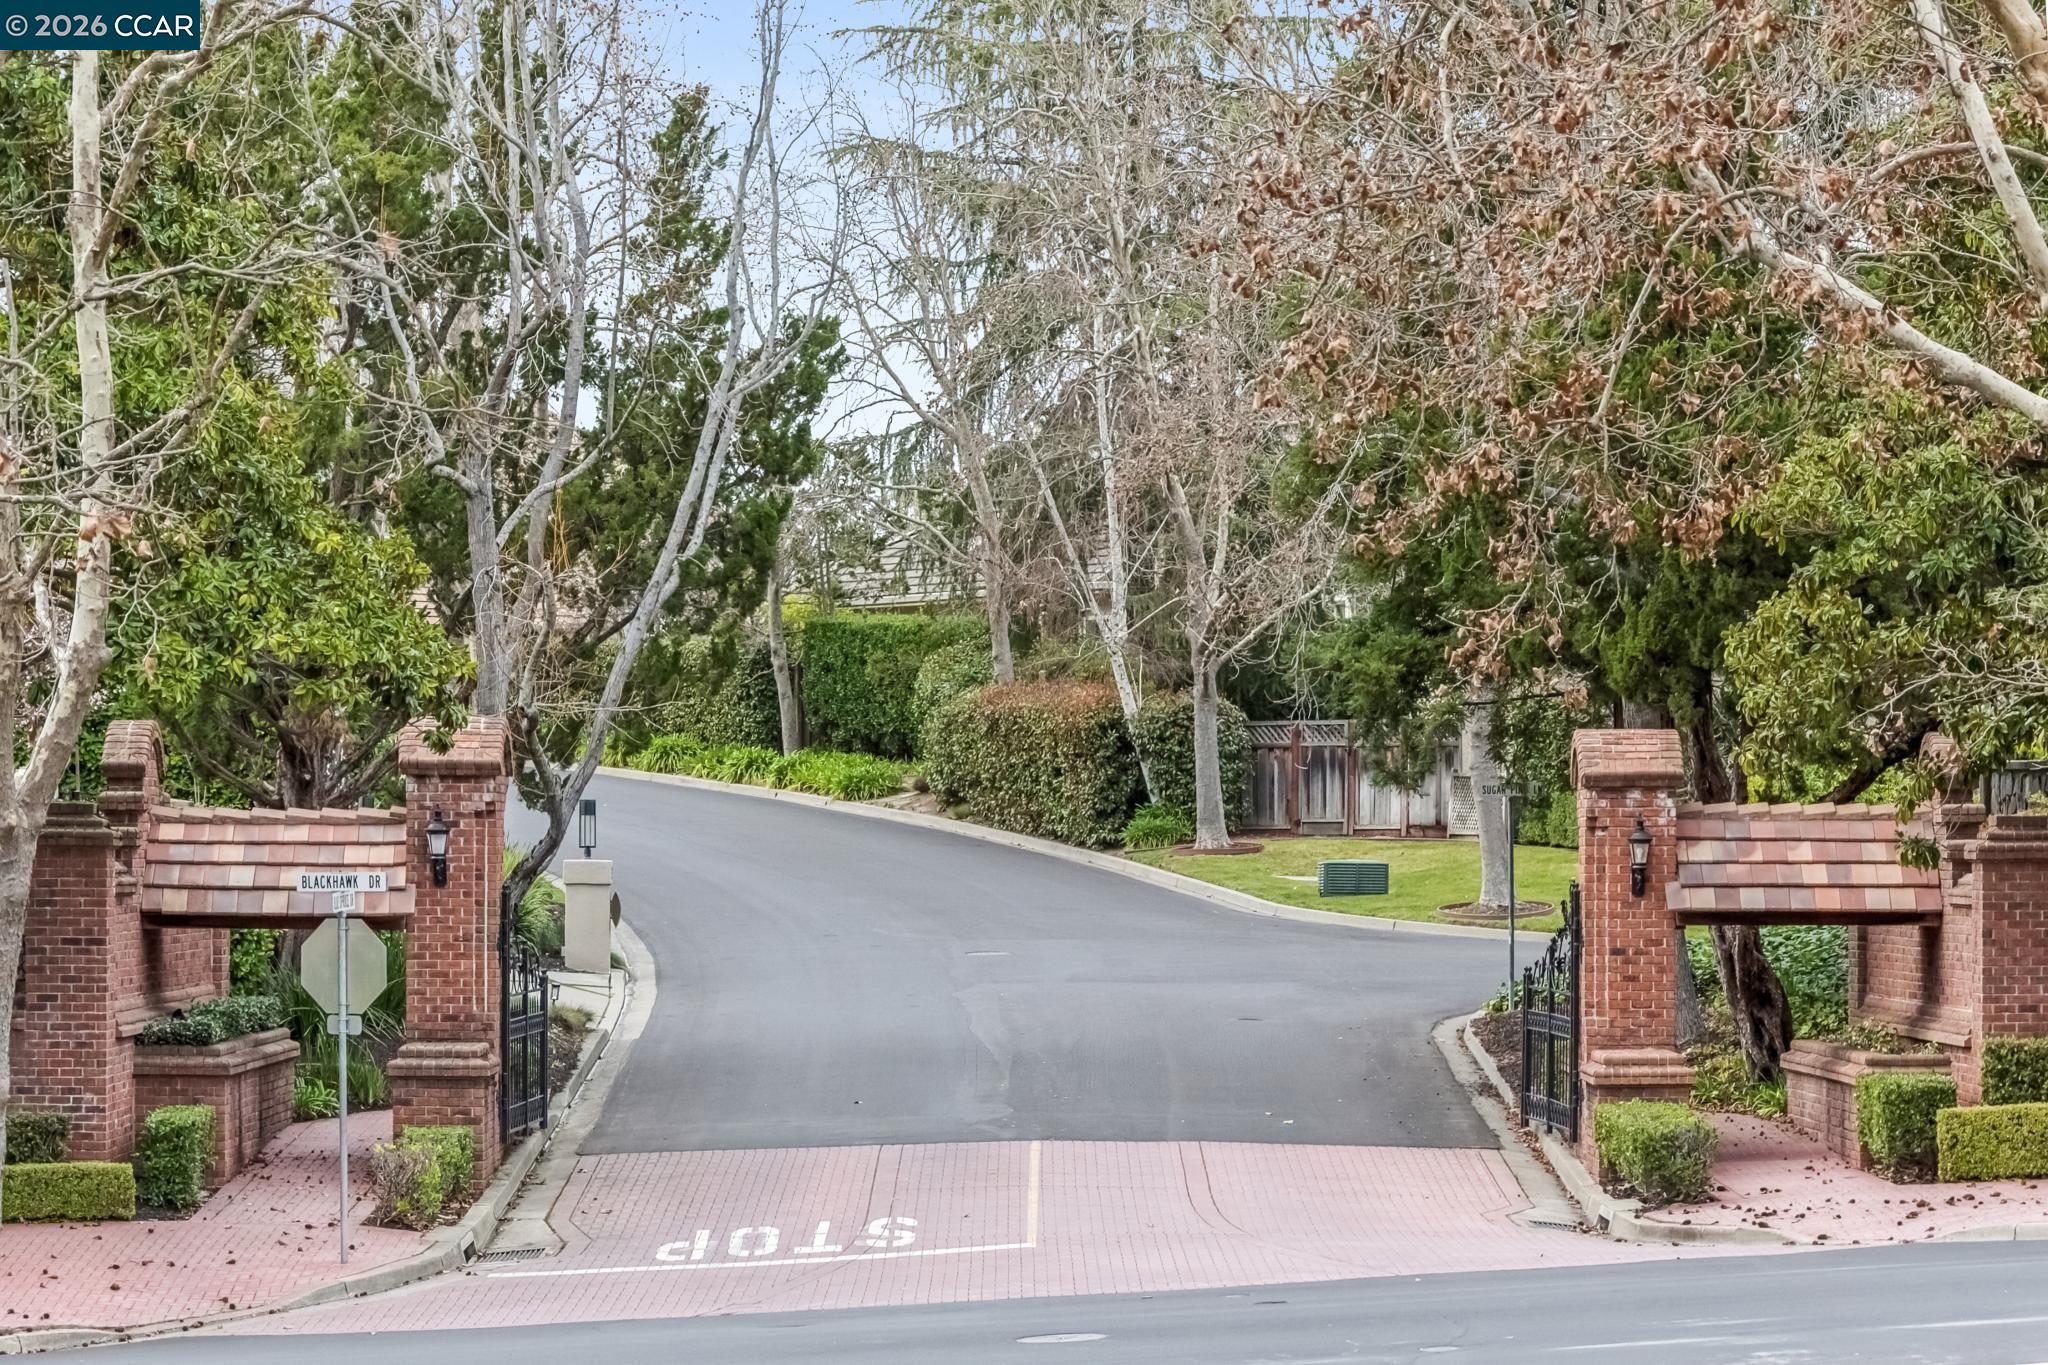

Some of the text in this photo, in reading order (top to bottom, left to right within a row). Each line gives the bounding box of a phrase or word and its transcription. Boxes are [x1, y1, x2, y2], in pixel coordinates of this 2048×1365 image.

[1482, 784, 1506, 795] SUGAR
[1510, 784, 1528, 795] PIN
[301, 874, 381, 889] BLACKHAWK DR
[655, 1216, 918, 1262] STOP
